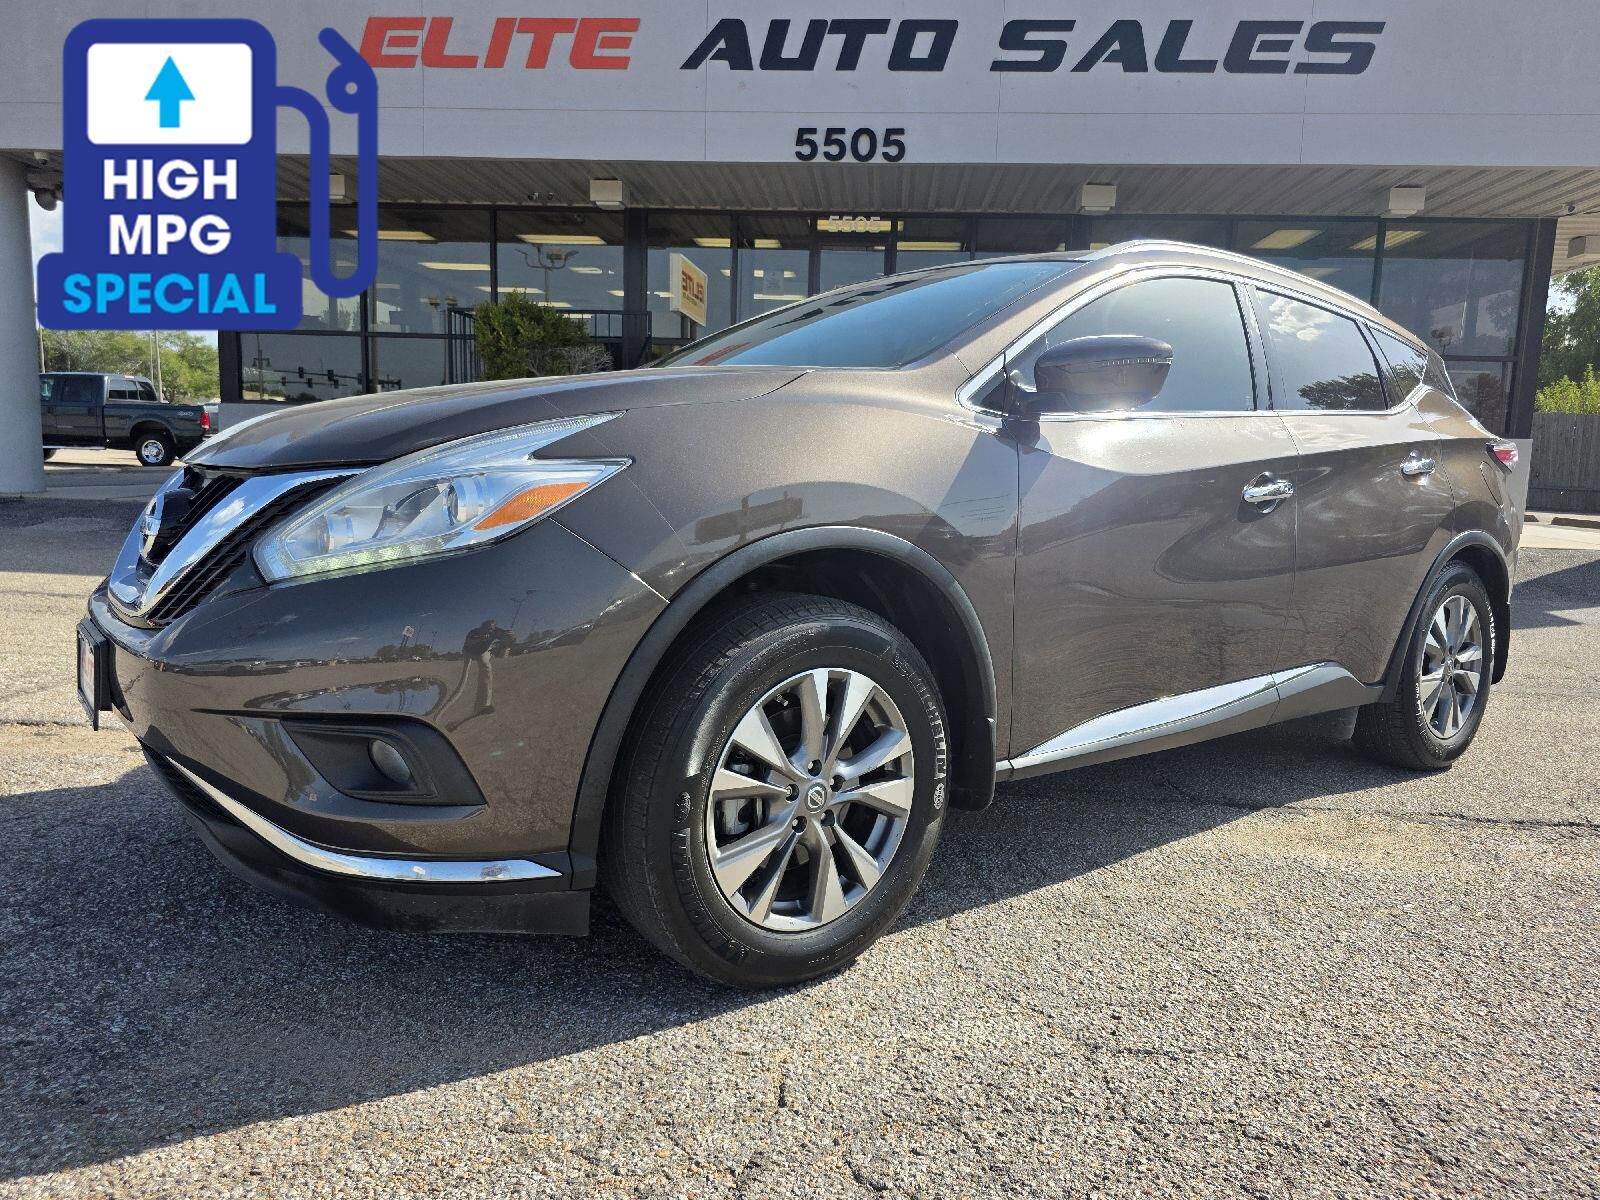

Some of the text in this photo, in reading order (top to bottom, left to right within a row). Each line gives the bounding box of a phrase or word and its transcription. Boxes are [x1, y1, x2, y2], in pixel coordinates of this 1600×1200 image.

[359, 17, 1386, 75] ELITE AUTO SALES
[794, 127, 907, 163] 5505
[828, 215, 881, 233] 5505
